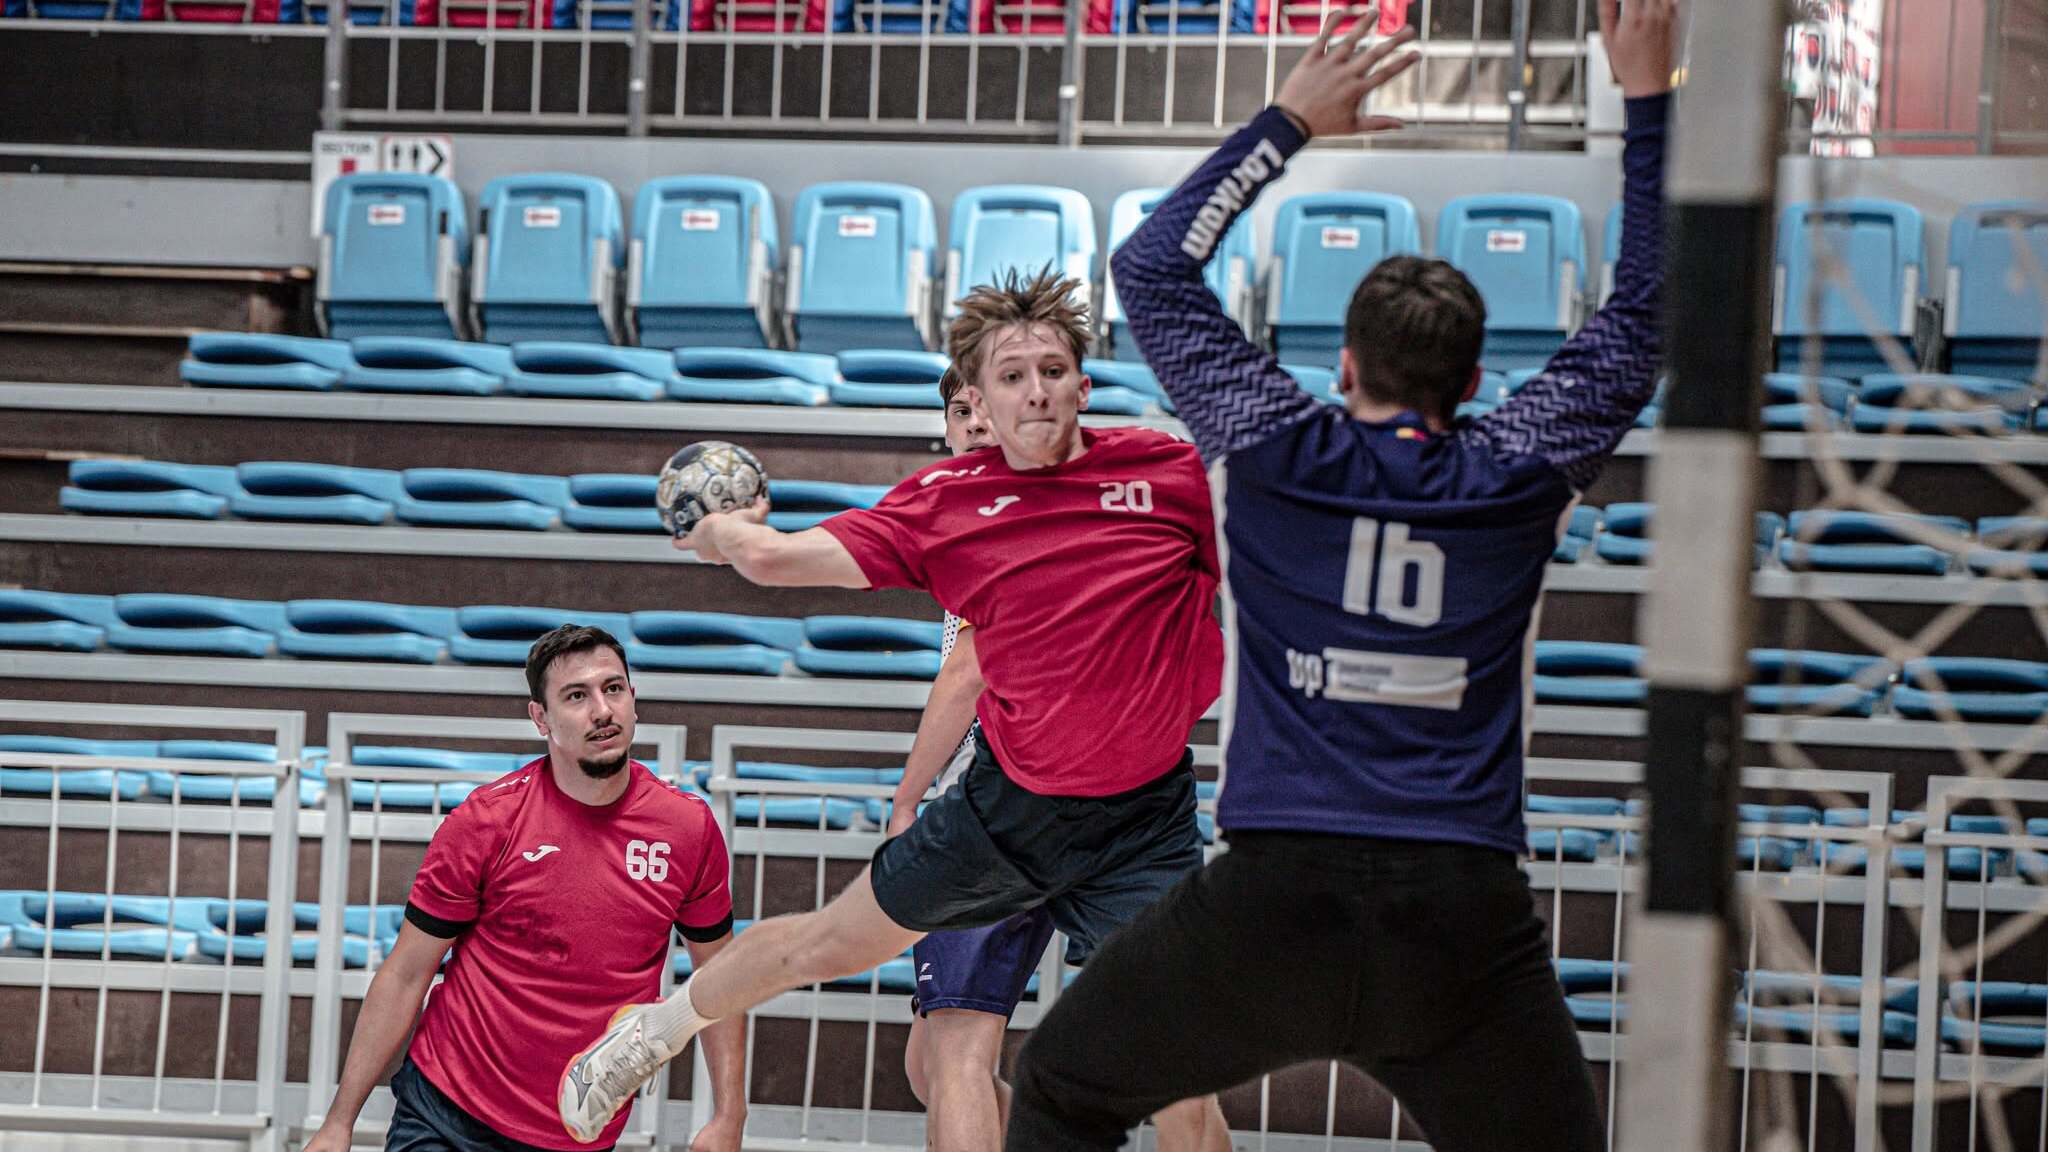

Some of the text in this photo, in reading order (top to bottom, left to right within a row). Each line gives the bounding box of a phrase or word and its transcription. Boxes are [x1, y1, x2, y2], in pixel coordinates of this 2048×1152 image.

[1099, 480, 1153, 513] 20
[1342, 516, 1446, 628] 16
[626, 839, 671, 882] 66
